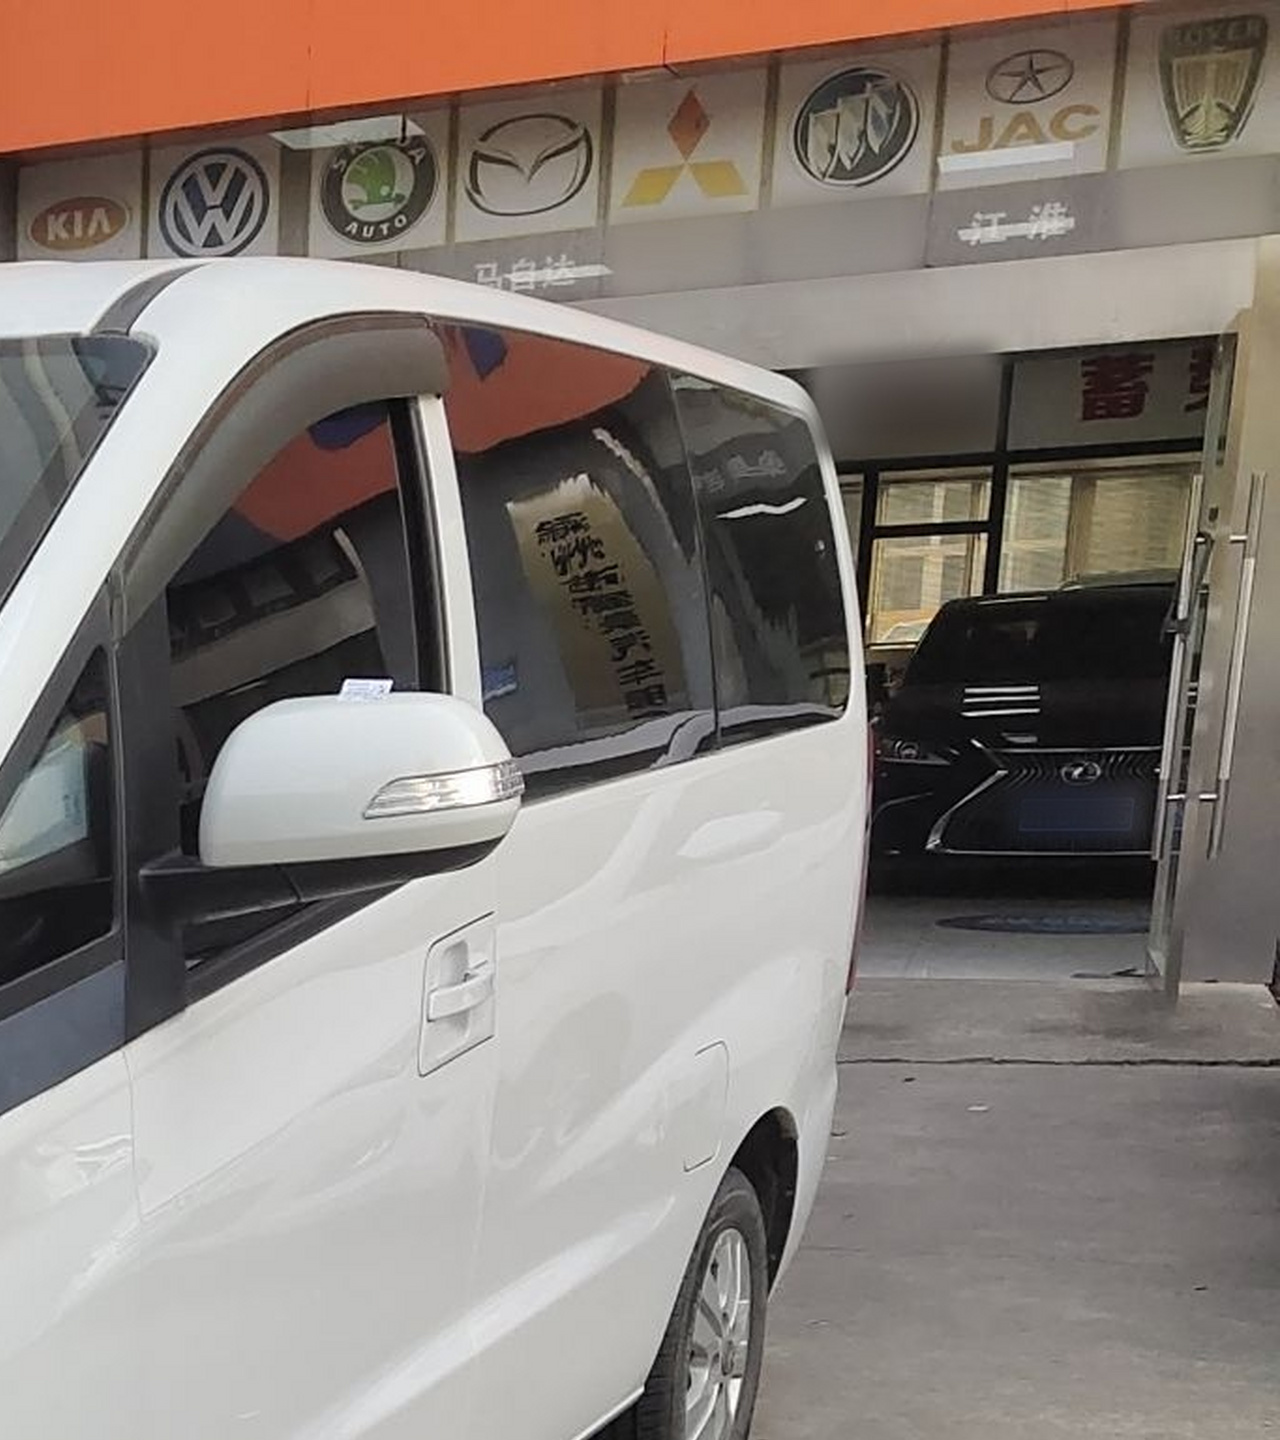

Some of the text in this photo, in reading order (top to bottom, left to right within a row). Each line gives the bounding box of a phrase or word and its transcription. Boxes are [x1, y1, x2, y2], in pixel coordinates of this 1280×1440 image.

[950, 104, 1101, 153] JAC
[46, 207, 111, 242] KIA
[345, 213, 408, 237] AUTO
